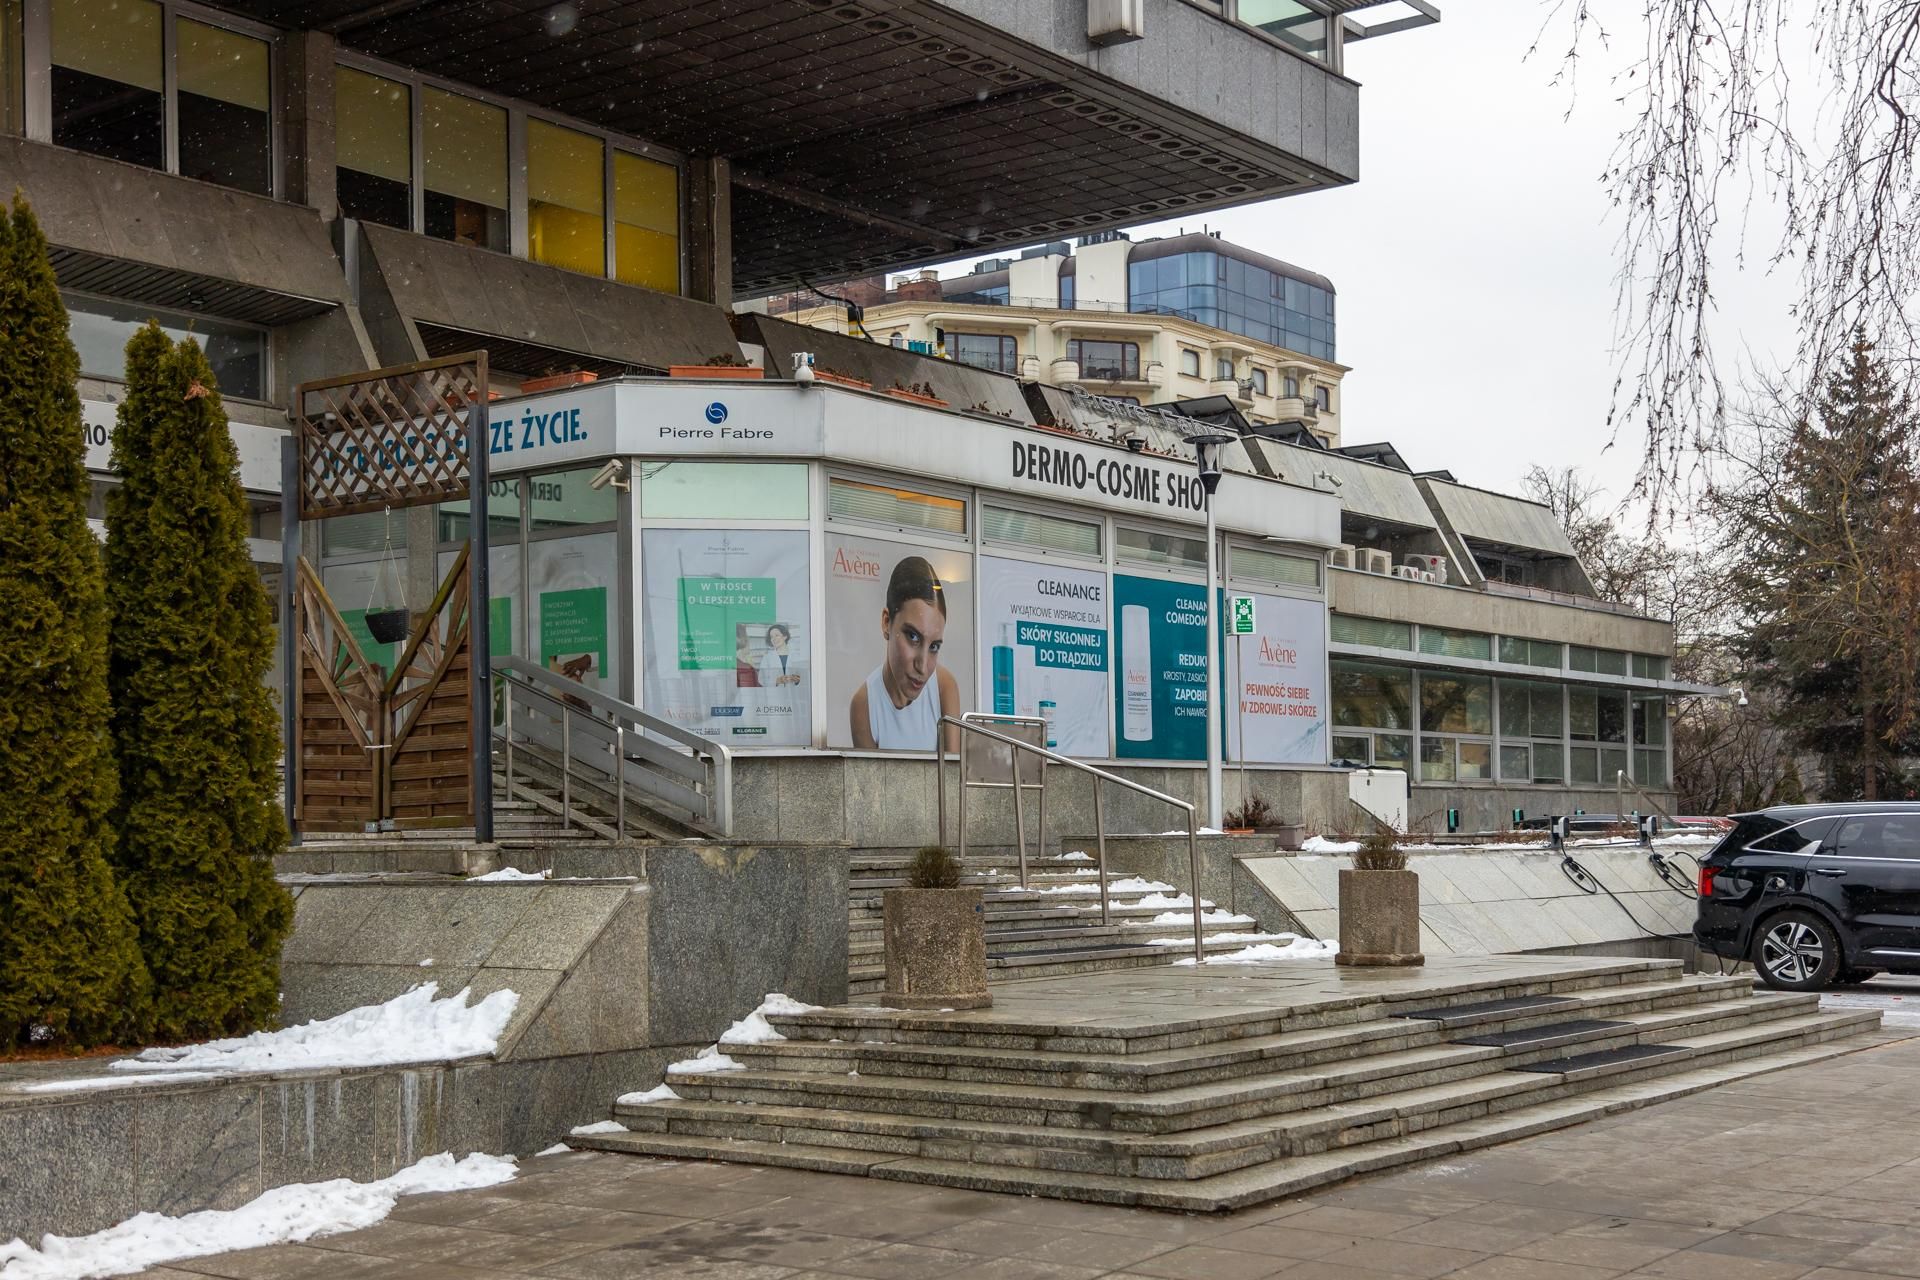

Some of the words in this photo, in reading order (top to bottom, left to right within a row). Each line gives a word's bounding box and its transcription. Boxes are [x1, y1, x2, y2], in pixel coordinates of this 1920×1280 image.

[521, 408, 588, 450] ŻYCIE.
[659, 427, 714, 439] Pierre
[721, 427, 774, 439] Fabre
[1013, 440, 1160, 504] DERMO-COSME
[1167, 472, 1208, 512] SHO
[833, 547, 880, 577] Avène
[701, 583, 711, 591] W
[715, 583, 753, 591] TROSCE
[1037, 579, 1101, 602] CLEANANCE
[688, 596, 696, 604] O
[699, 596, 735, 605] LEPSZE
[738, 594, 767, 604] ŻYCIE
[1010, 604, 1052, 618] WYJĄTKOWE
[1053, 609, 1087, 622] WSPARCIE
[1087, 613, 1101, 624] DLA
[1020, 625, 1052, 643] SKÓRY
[1054, 631, 1101, 648] SKŁONNEJ
[1040, 649, 1055, 662] DO
[1056, 650, 1101, 668] TRĄDZIKU
[1259, 635, 1297, 664] Avène
[1163, 671, 1186, 682] KROSTY,
[1246, 683, 1286, 698] PEWNOŚĆ
[1287, 687, 1310, 700] SIEBIE
[1174, 706, 1186, 716] ICH
[1249, 702, 1287, 716] ZDROWEJ
[1288, 702, 1317, 718] SKÓRZE
